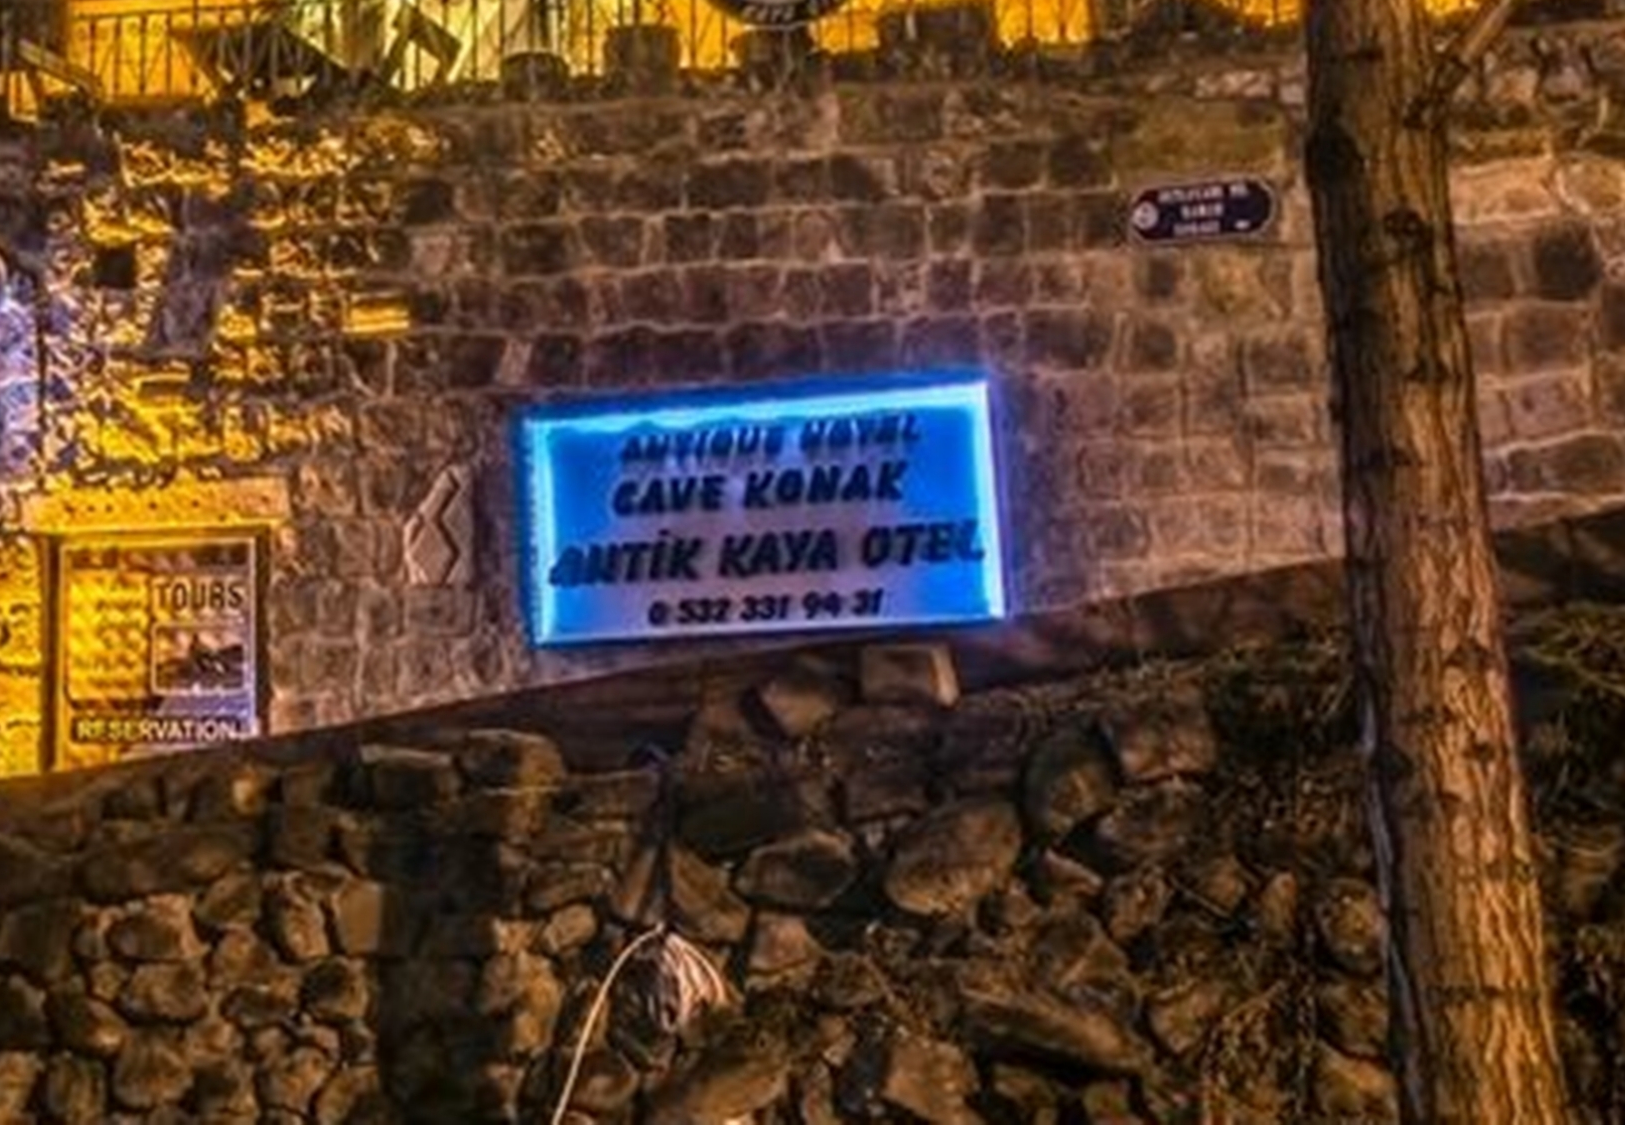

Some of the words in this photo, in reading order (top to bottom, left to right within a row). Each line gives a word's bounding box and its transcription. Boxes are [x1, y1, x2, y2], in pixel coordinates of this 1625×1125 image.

[612, 475, 726, 516] CAVE
[743, 460, 908, 509] KONAK
[548, 529, 702, 586] ANTİK
[719, 529, 838, 576] KAYA
[859, 520, 985, 568] OTEL
[155, 581, 245, 611] TOURS
[648, 601, 666, 626] 0
[678, 596, 730, 622] 532
[740, 594, 792, 620] 331
[802, 592, 841, 618] 94
[850, 589, 885, 616] 31
[75, 720, 236, 741] RESERVATION
